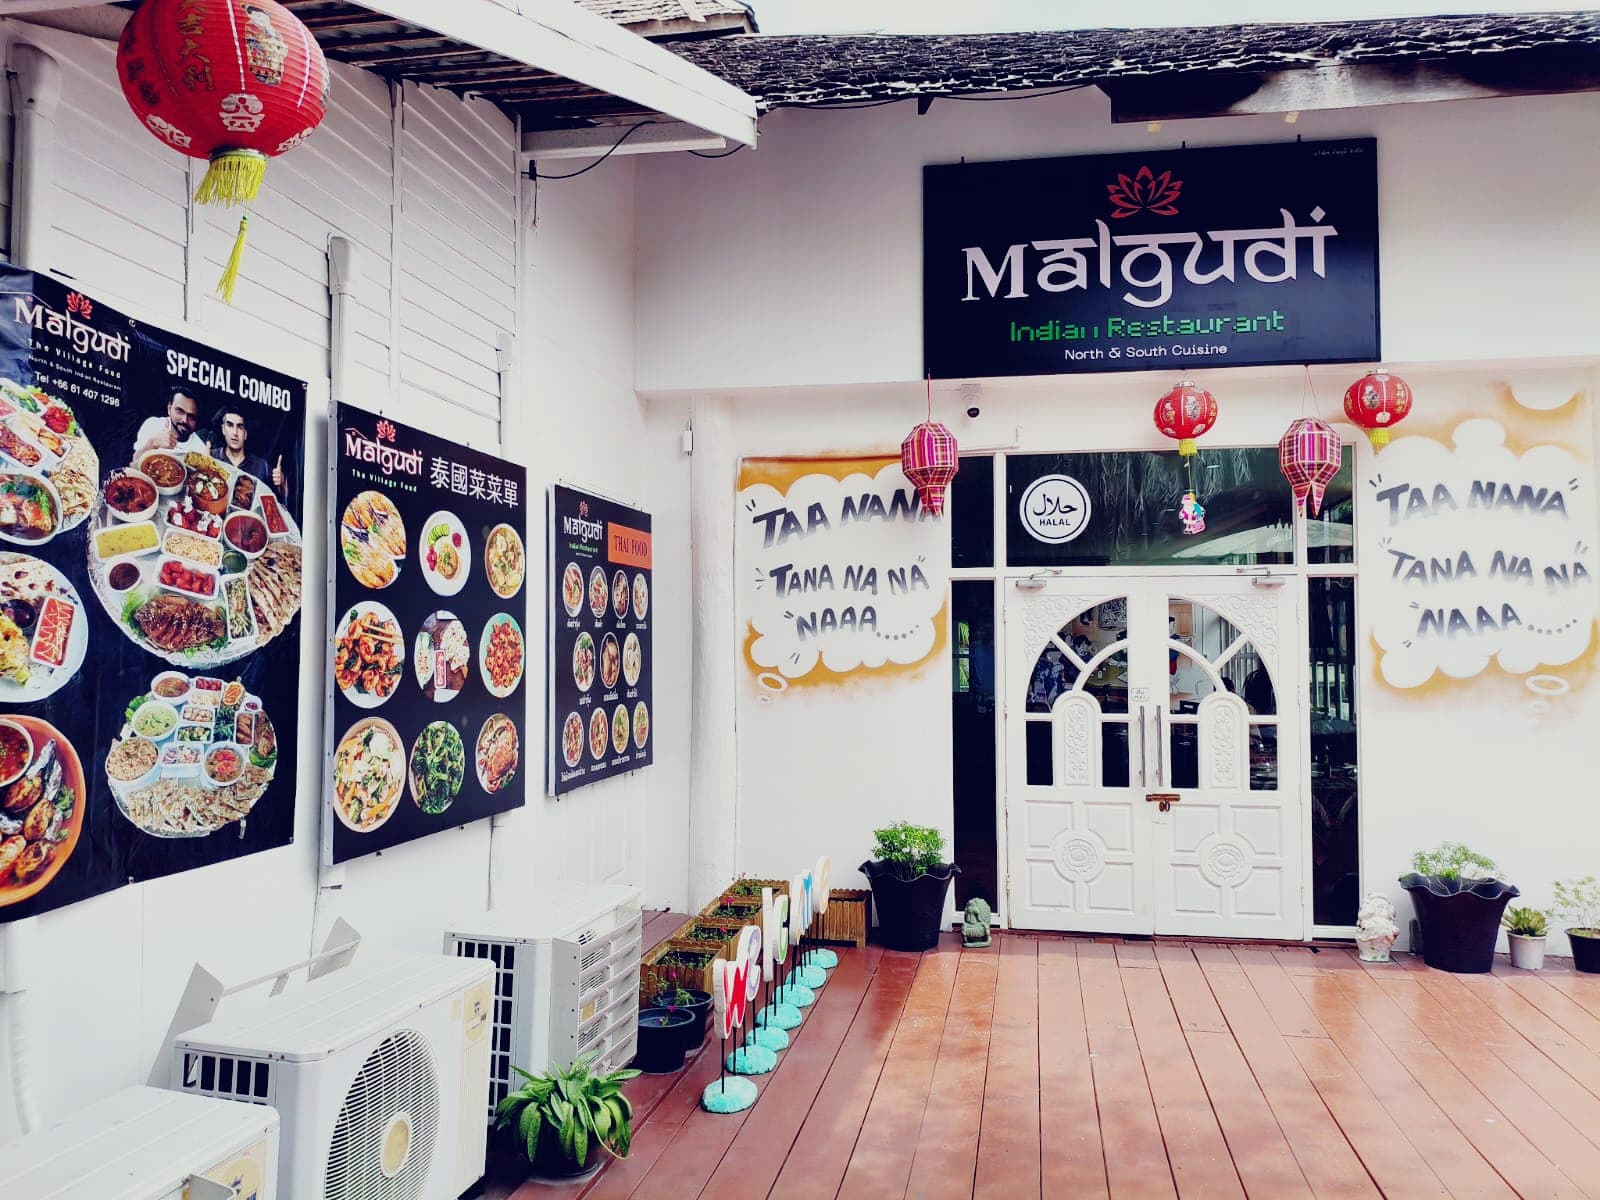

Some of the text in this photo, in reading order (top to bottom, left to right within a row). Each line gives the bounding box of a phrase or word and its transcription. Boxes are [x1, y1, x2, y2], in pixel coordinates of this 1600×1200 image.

[960, 206, 1339, 308] Malgudi
[14, 296, 132, 363] Malgudi
[1107, 310, 1285, 338] Restaurant
[1065, 344, 1228, 360] North & South Cuisine
[34, 371, 49, 384] Tel
[83, 388, 99, 400] 407
[166, 349, 292, 412] SPECIAL COMBO
[344, 433, 423, 476] Malgudi
[430, 456, 519, 509] 泰國菜菜單
[752, 488, 943, 548] TAA NAN
[1033, 493, 1078, 516] حلال
[1039, 518, 1071, 526] HALAL
[1376, 480, 1569, 527] TAA NANA
[563, 514, 603, 543] Malgudi
[614, 535, 648, 557] THAI FOOD
[769, 564, 930, 599] TANA NA NA
[1387, 549, 1592, 594] TANA NA NA
